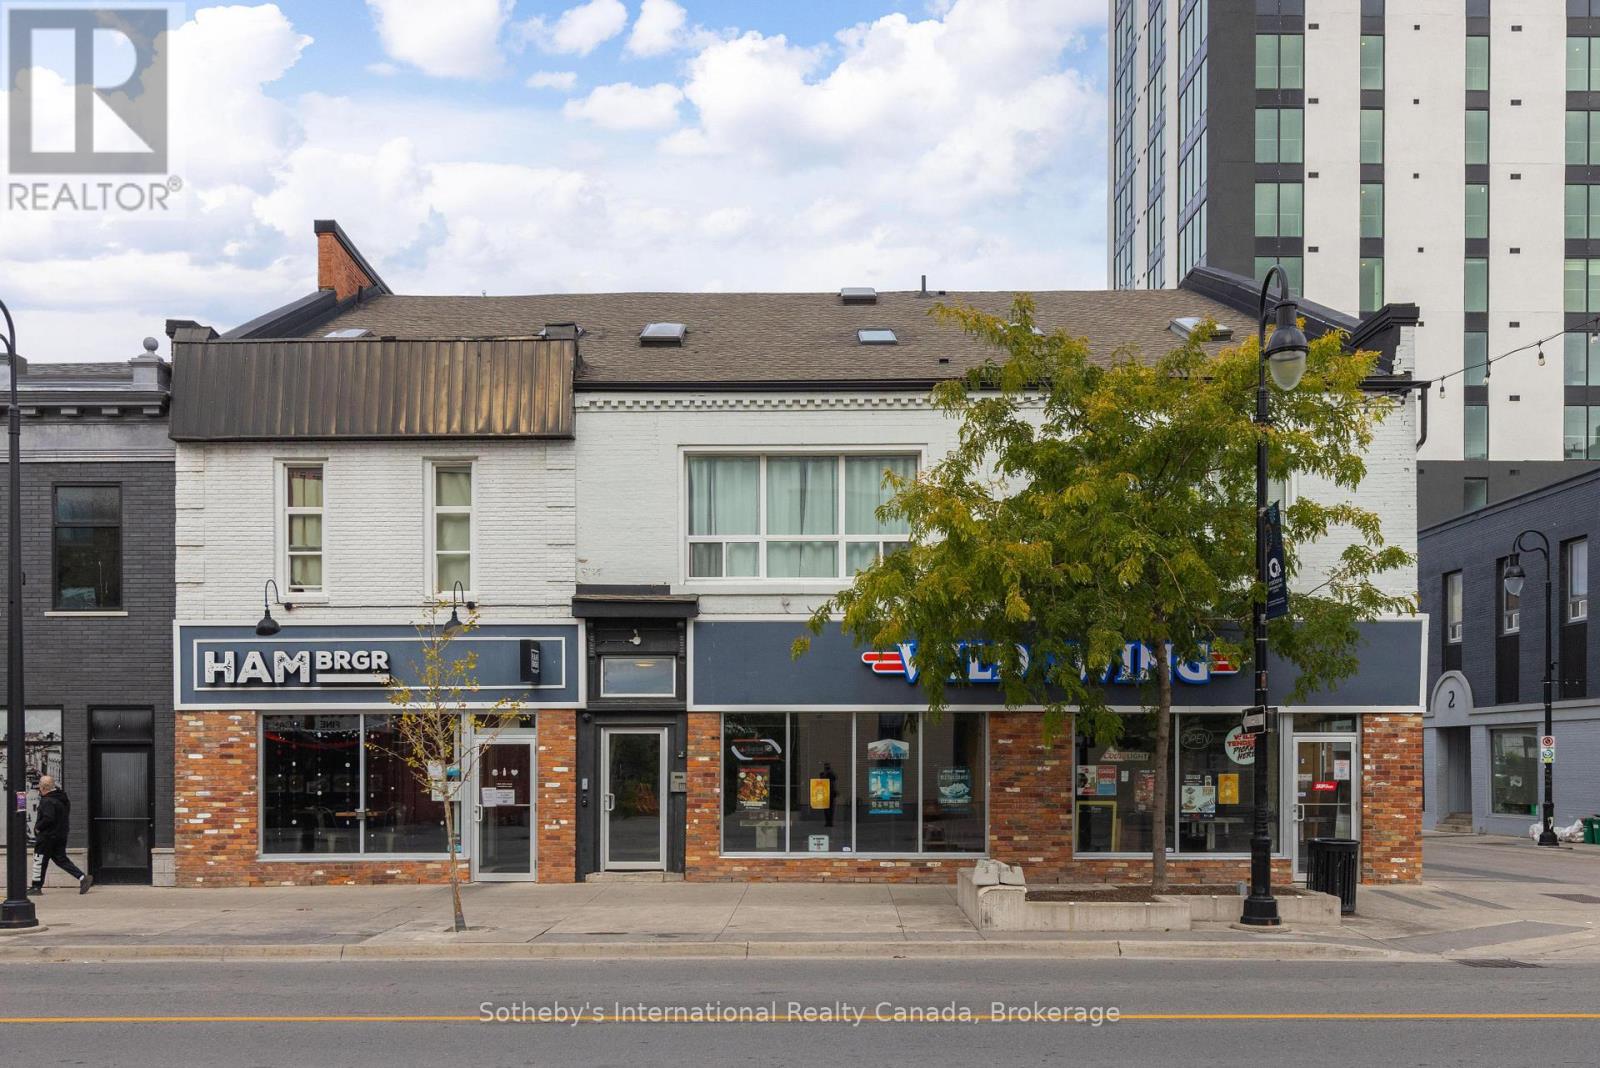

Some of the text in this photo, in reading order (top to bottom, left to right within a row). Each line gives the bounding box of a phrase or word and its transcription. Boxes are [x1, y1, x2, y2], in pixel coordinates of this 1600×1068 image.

[204, 650, 389, 683] HAM BRGR
[1448, 690, 1455, 708] 2
